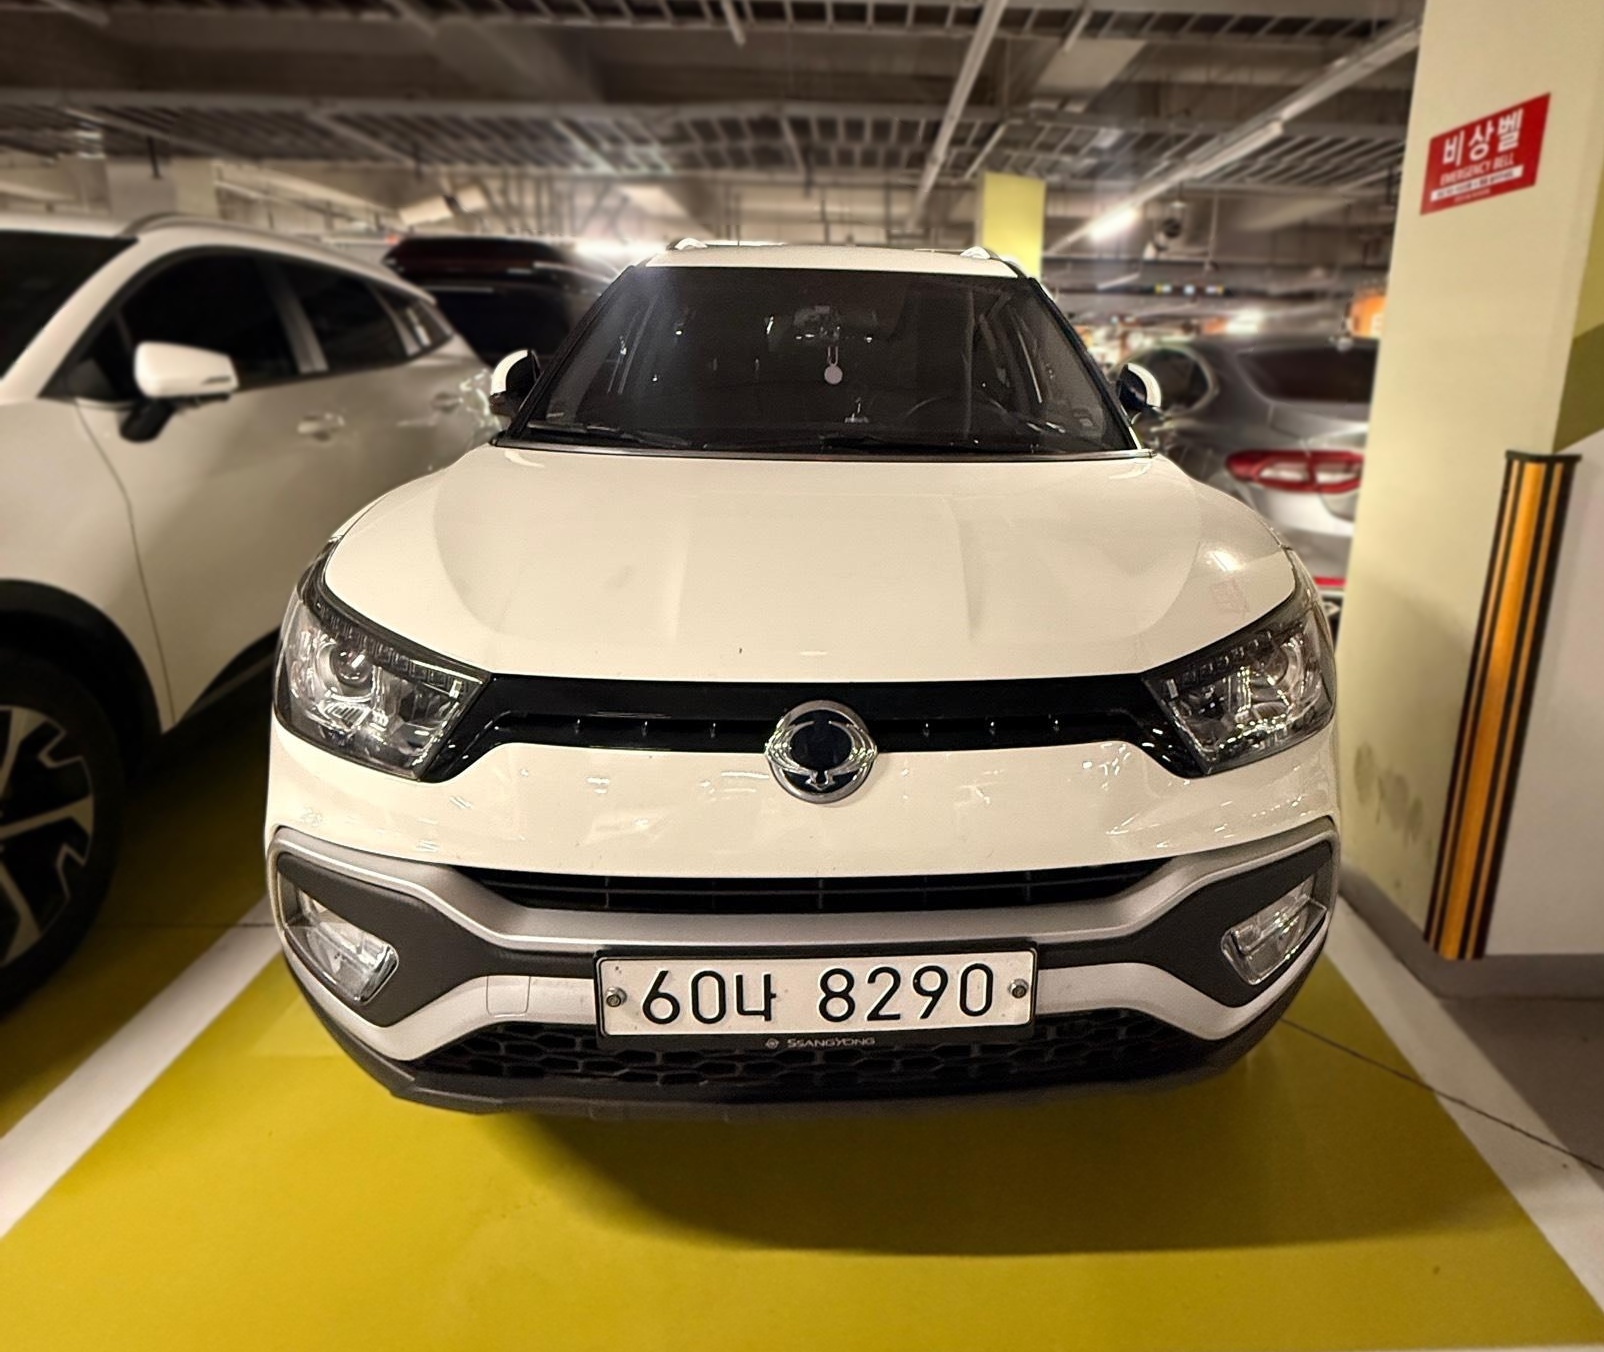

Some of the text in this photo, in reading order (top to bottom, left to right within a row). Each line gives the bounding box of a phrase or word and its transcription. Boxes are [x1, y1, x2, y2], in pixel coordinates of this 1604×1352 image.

[1442, 108, 1524, 167] 비상벨
[1440, 160, 1491, 186] EMERGENCY
[641, 962, 994, 1025] 60나 8290
[787, 1037, 876, 1049] SSANGYONG
